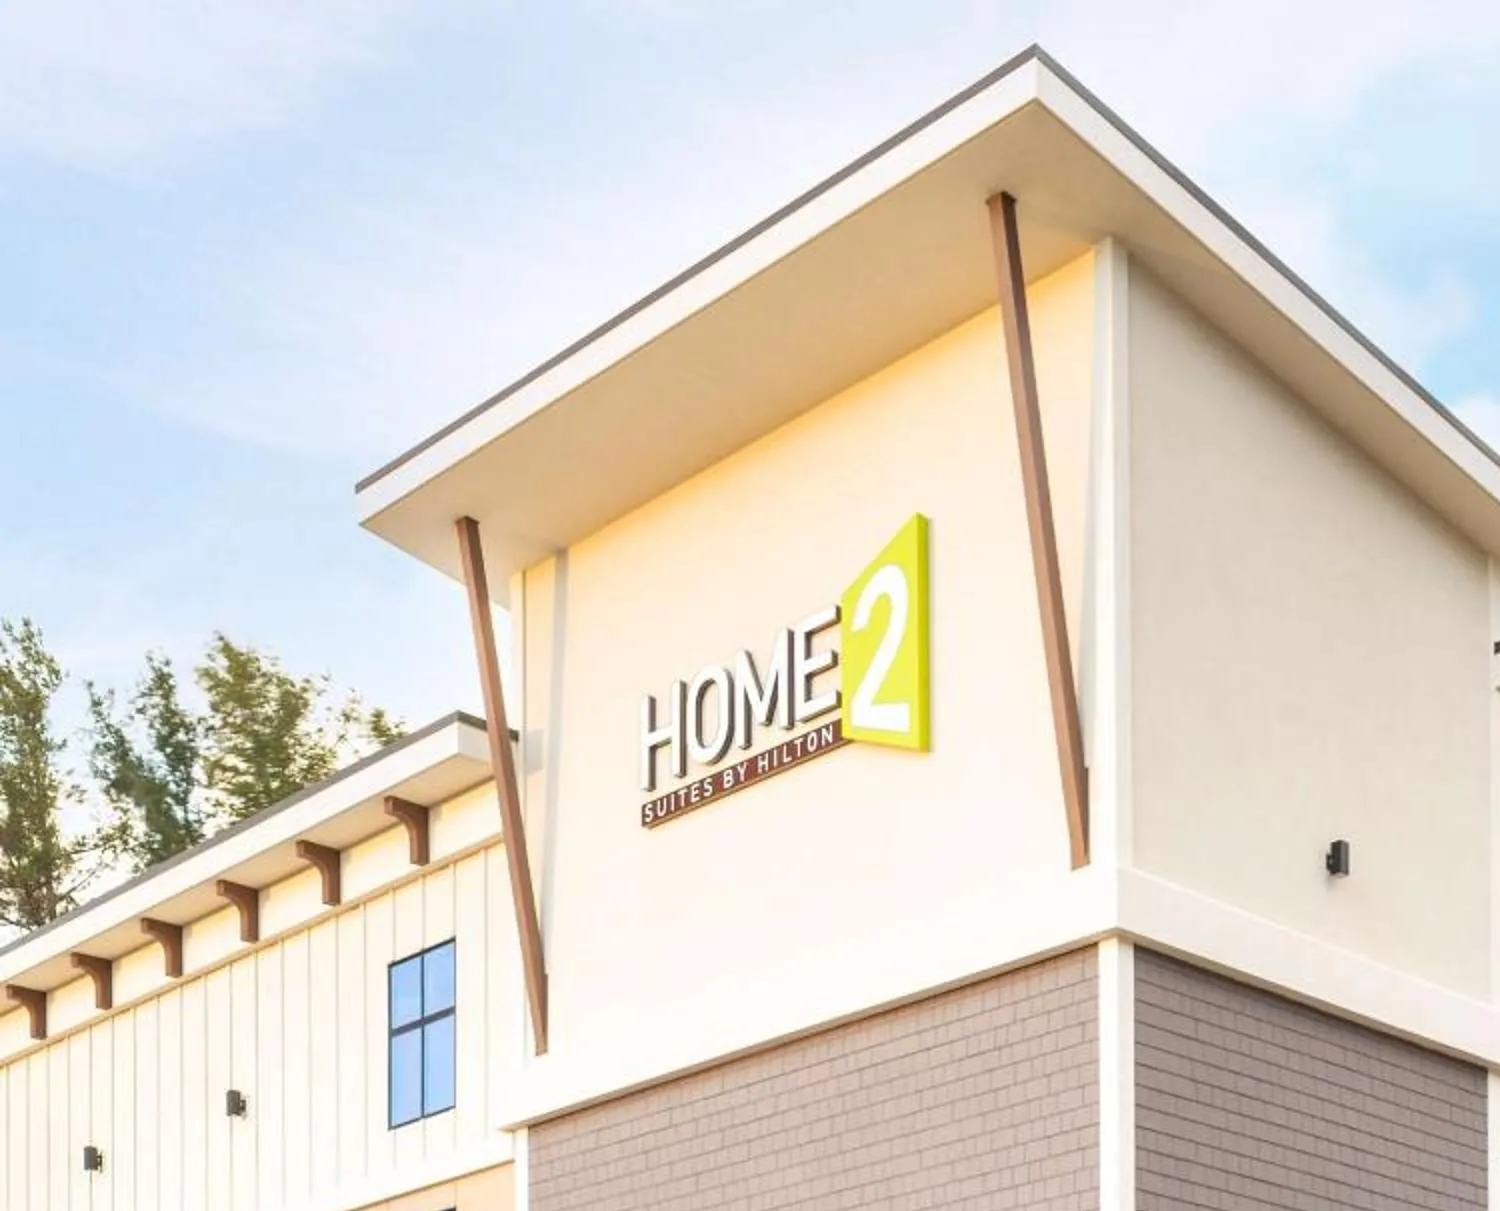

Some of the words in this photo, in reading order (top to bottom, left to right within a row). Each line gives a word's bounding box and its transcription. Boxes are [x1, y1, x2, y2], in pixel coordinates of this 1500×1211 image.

[643, 786, 714, 823] SUITES
[723, 763, 749, 788] BY
[757, 725, 834, 774] HILTON
